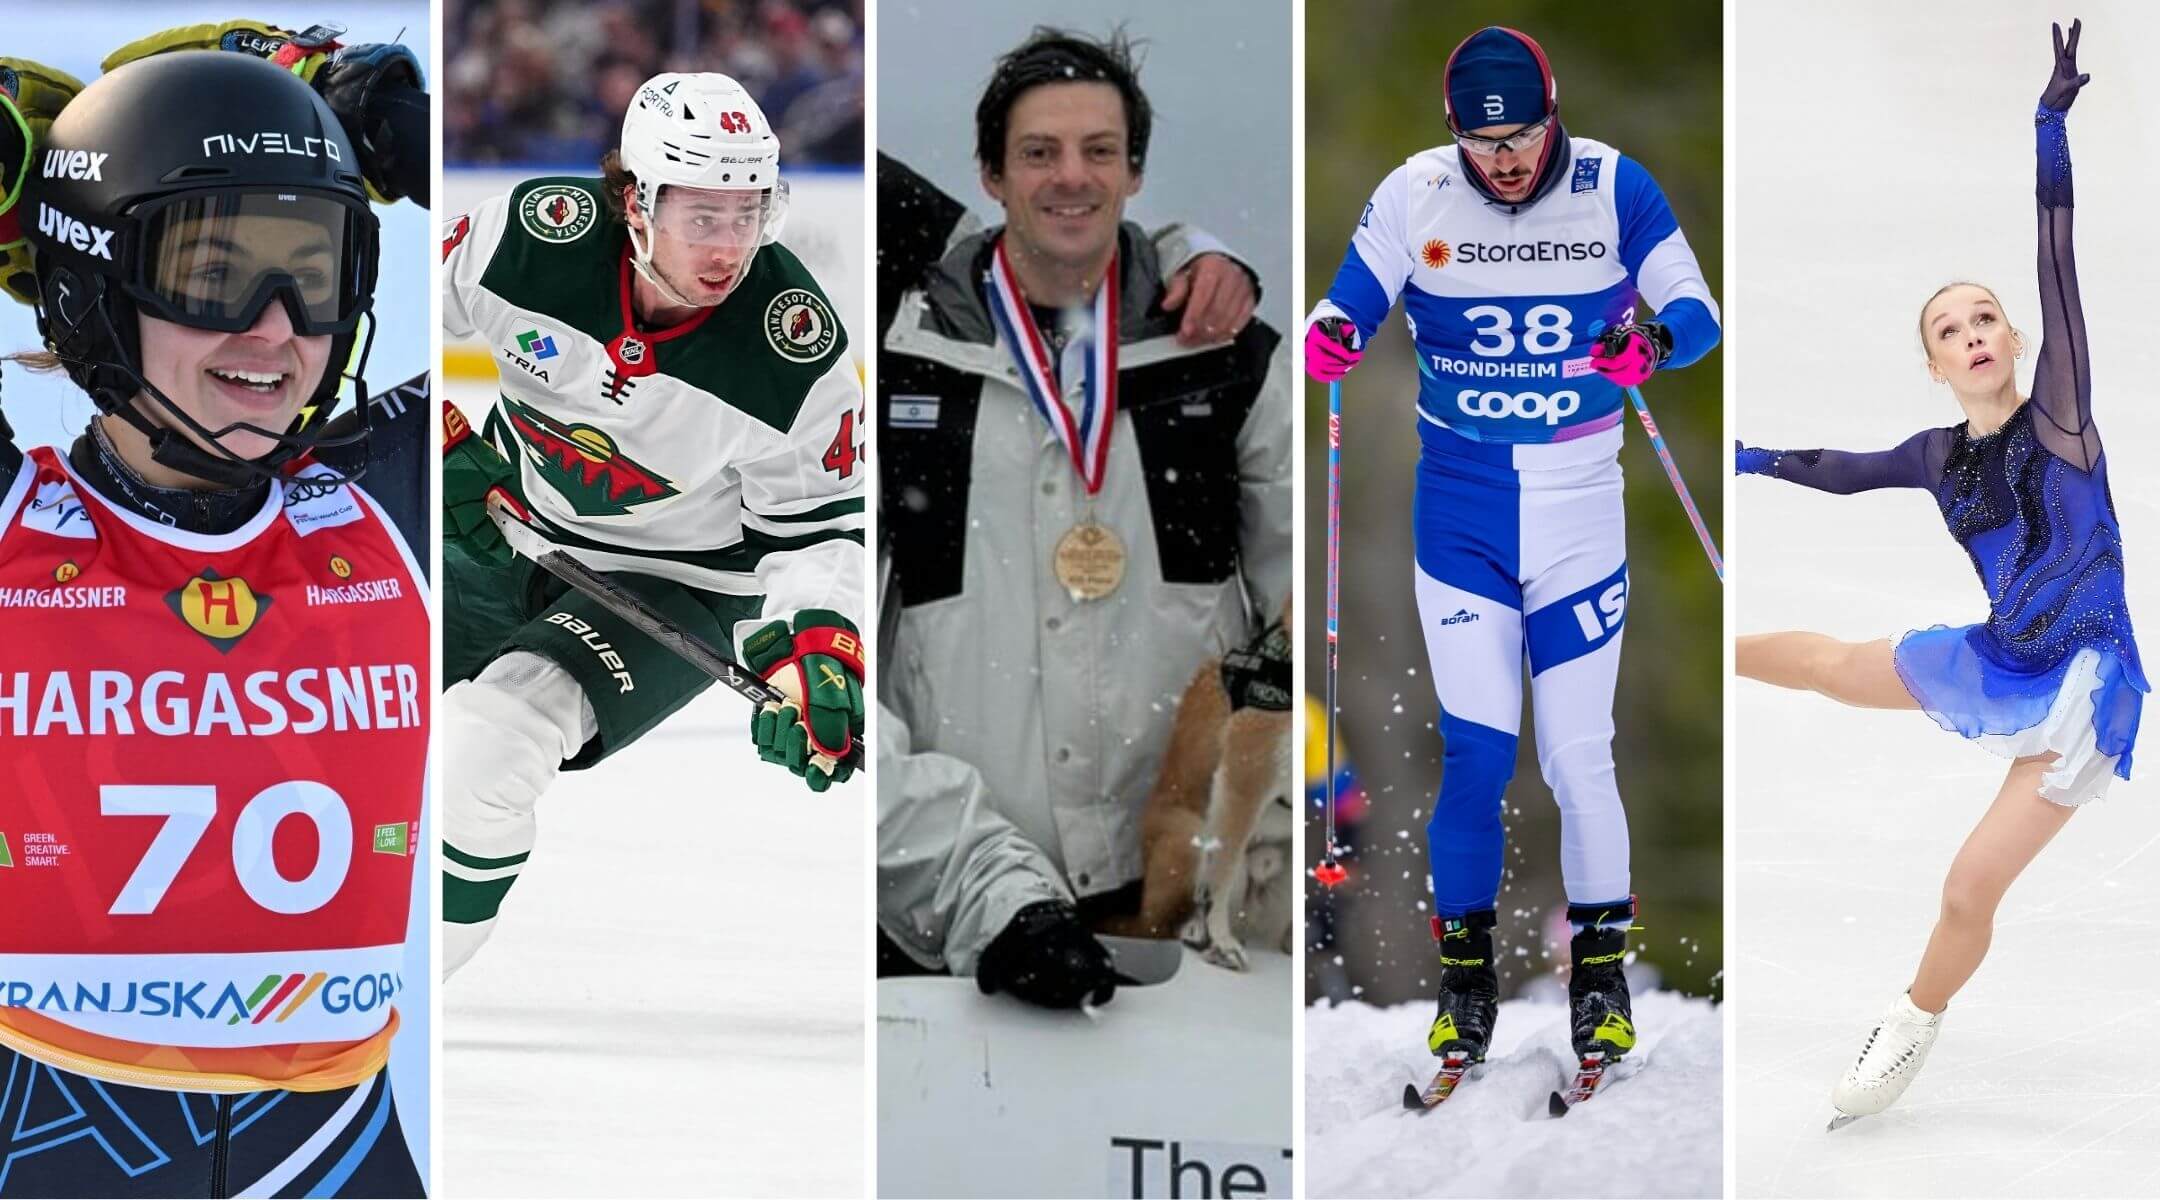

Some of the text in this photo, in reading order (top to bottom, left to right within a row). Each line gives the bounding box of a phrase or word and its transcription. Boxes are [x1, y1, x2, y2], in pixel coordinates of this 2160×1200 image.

[240, 33, 280, 52] LEVE
[640, 87, 674, 118] FORTRA
[720, 111, 752, 134] 43
[203, 132, 341, 162] NIVELCO
[720, 156, 763, 164] BAUER
[42, 149, 109, 182] uvex
[525, 190, 591, 238] MINNESOTA WILD
[38, 203, 114, 261] uvex
[1456, 240, 1606, 264] StoraEnso
[769, 294, 832, 355] MINNESOTA WILD
[1462, 304, 1574, 358] 38
[503, 348, 551, 384] TRIA
[1431, 355, 1557, 378] TRONDHEIM
[1457, 390, 1581, 426] coop
[821, 407, 865, 480] 4
[339, 505, 353, 514] Cup
[0, 586, 126, 609] HARGASSNER
[306, 578, 402, 606] HARGASSNER
[545, 611, 635, 695] BAUER
[0, 664, 421, 737] HARGASSNER
[23, 833, 57, 844] GREEN.
[24, 844, 71, 855] CREATIVE.
[99, 780, 354, 915] 70
[25, 856, 59, 867] SMART.
[1440, 955, 1484, 966] SCHER
[321, 972, 403, 1014] GOR
[1111, 1136, 1268, 1200] The
